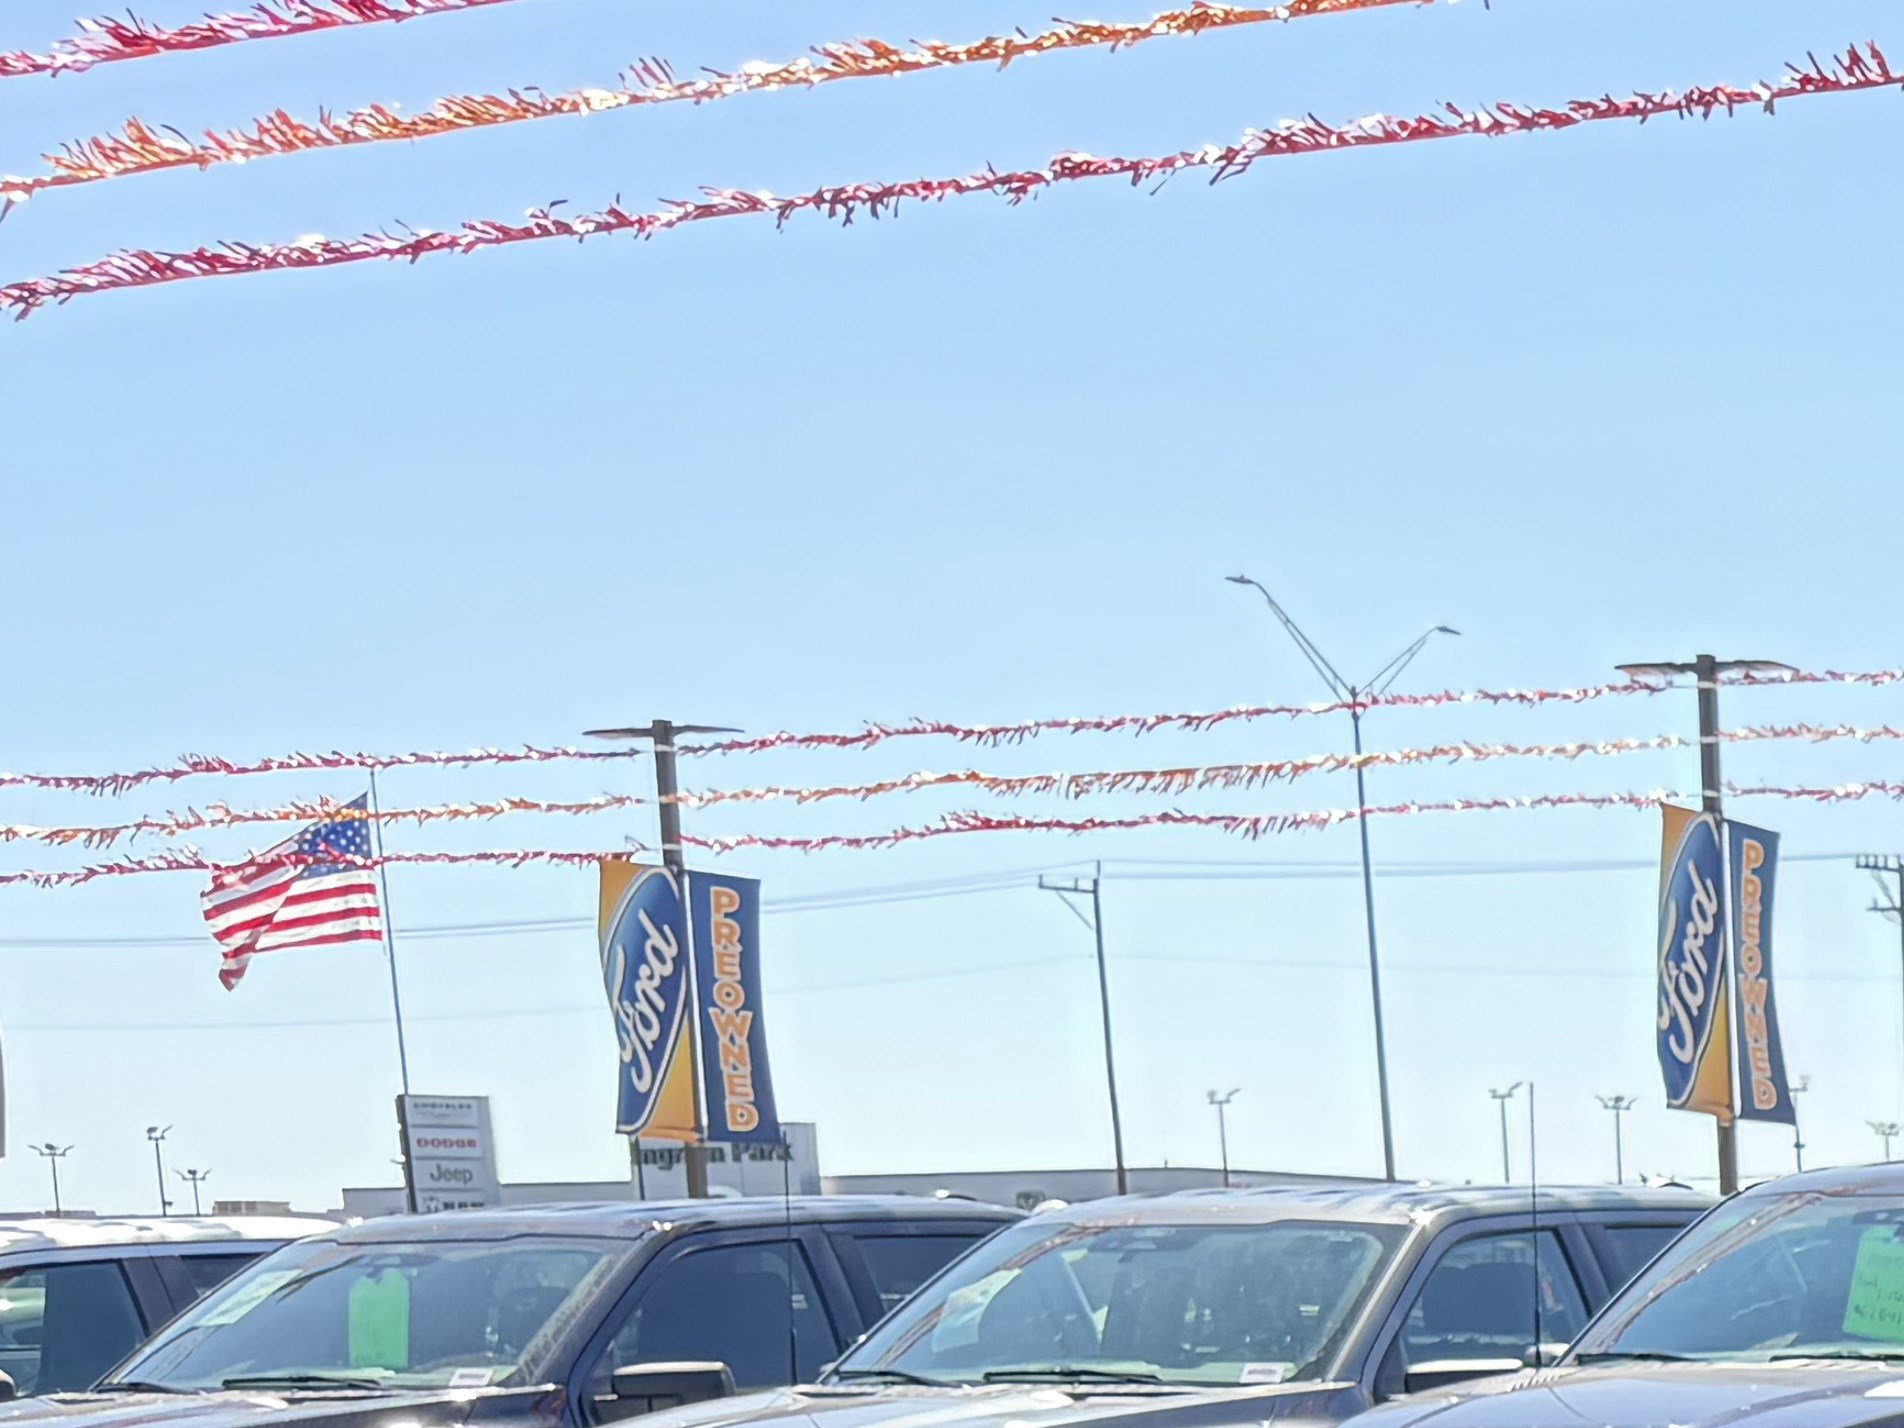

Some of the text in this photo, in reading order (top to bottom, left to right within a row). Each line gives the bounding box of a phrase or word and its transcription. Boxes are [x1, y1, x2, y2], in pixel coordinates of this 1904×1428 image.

[613, 908, 679, 1094] Ford
[708, 886, 760, 1132] PREOWNED
[1657, 857, 1719, 1064] Ford
[1738, 838, 1778, 1111] PREOWNED
[429, 1163, 474, 1185] Jeep
